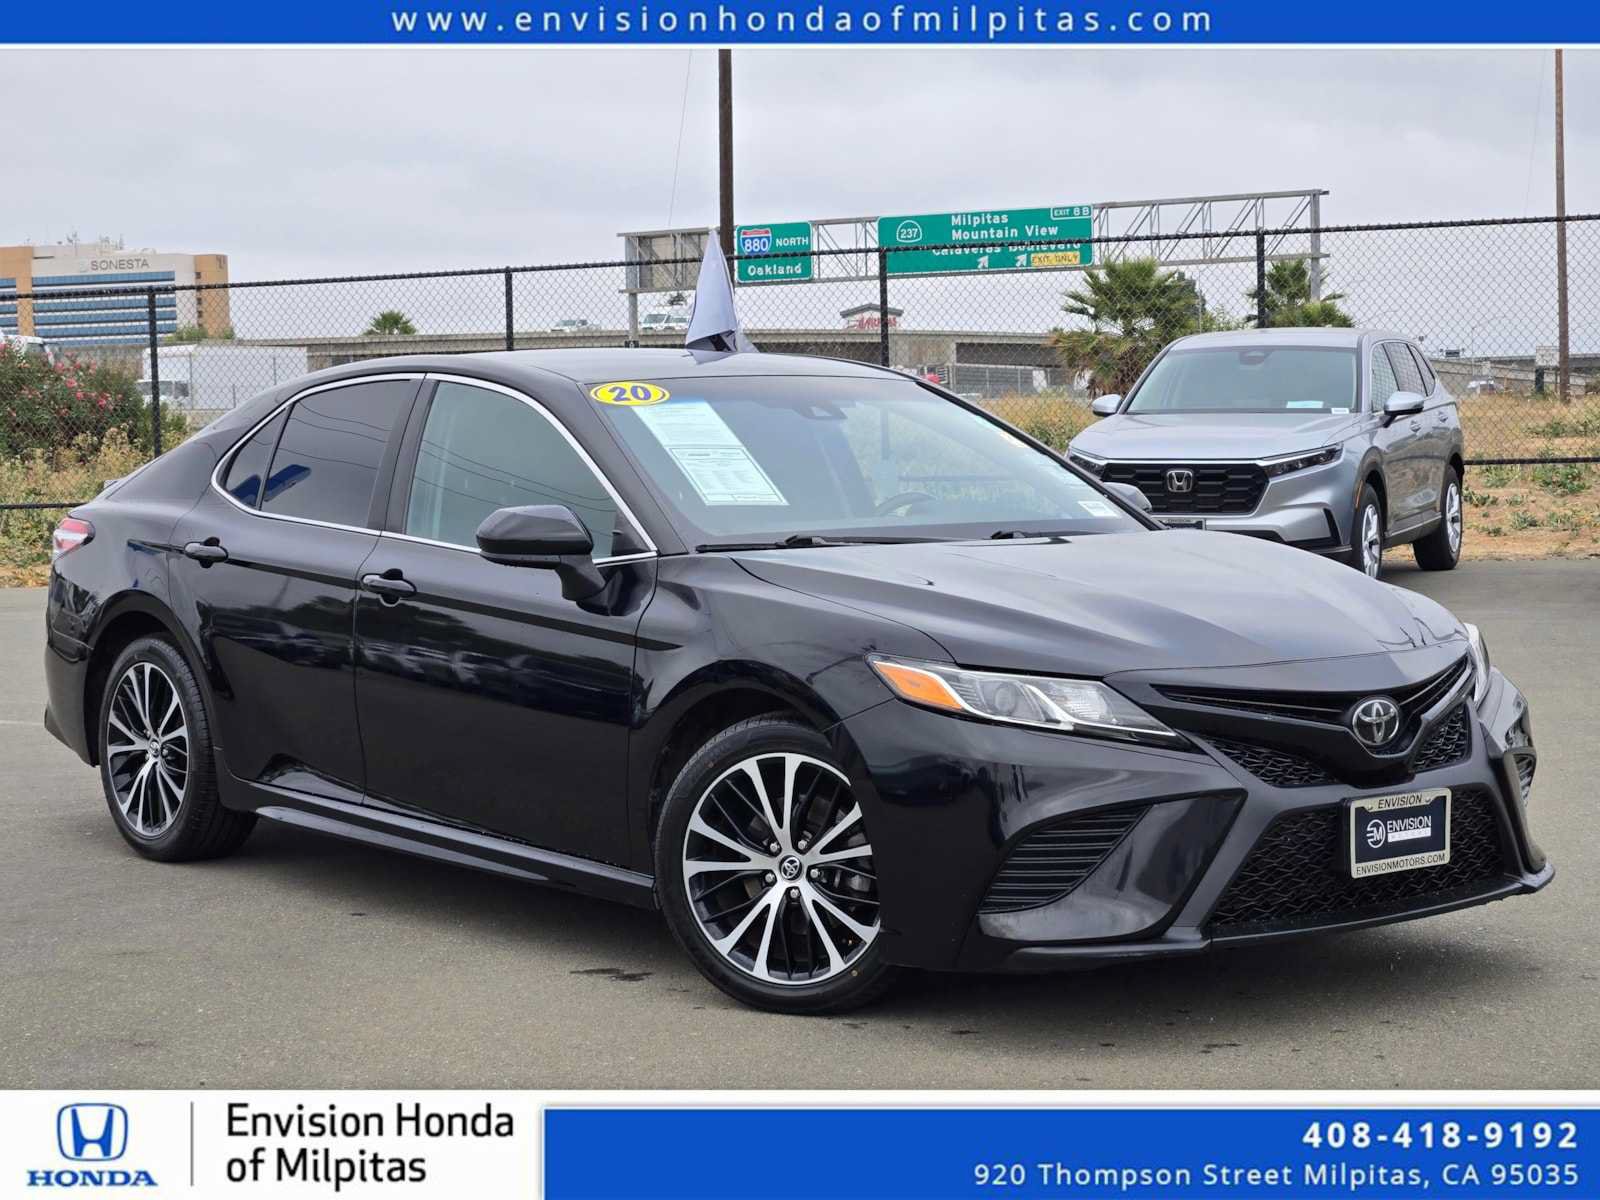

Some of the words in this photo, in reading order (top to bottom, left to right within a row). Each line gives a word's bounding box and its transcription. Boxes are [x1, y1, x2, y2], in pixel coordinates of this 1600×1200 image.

[951, 213, 1009, 227] Milpitas
[900, 227, 918, 239] 237
[951, 227, 1018, 241] Mountain
[1025, 224, 1058, 237] View
[744, 238, 769, 252] 880
[775, 236, 809, 247] NORTH
[90, 258, 150, 271] SONESTA
[747, 262, 802, 276] Oakland
[608, 385, 651, 402] 20
[1377, 794, 1422, 809] ENVISION
[1387, 815, 1432, 833] ENVISION
[1356, 853, 1446, 876] ENVISIONMOTORS.COM
